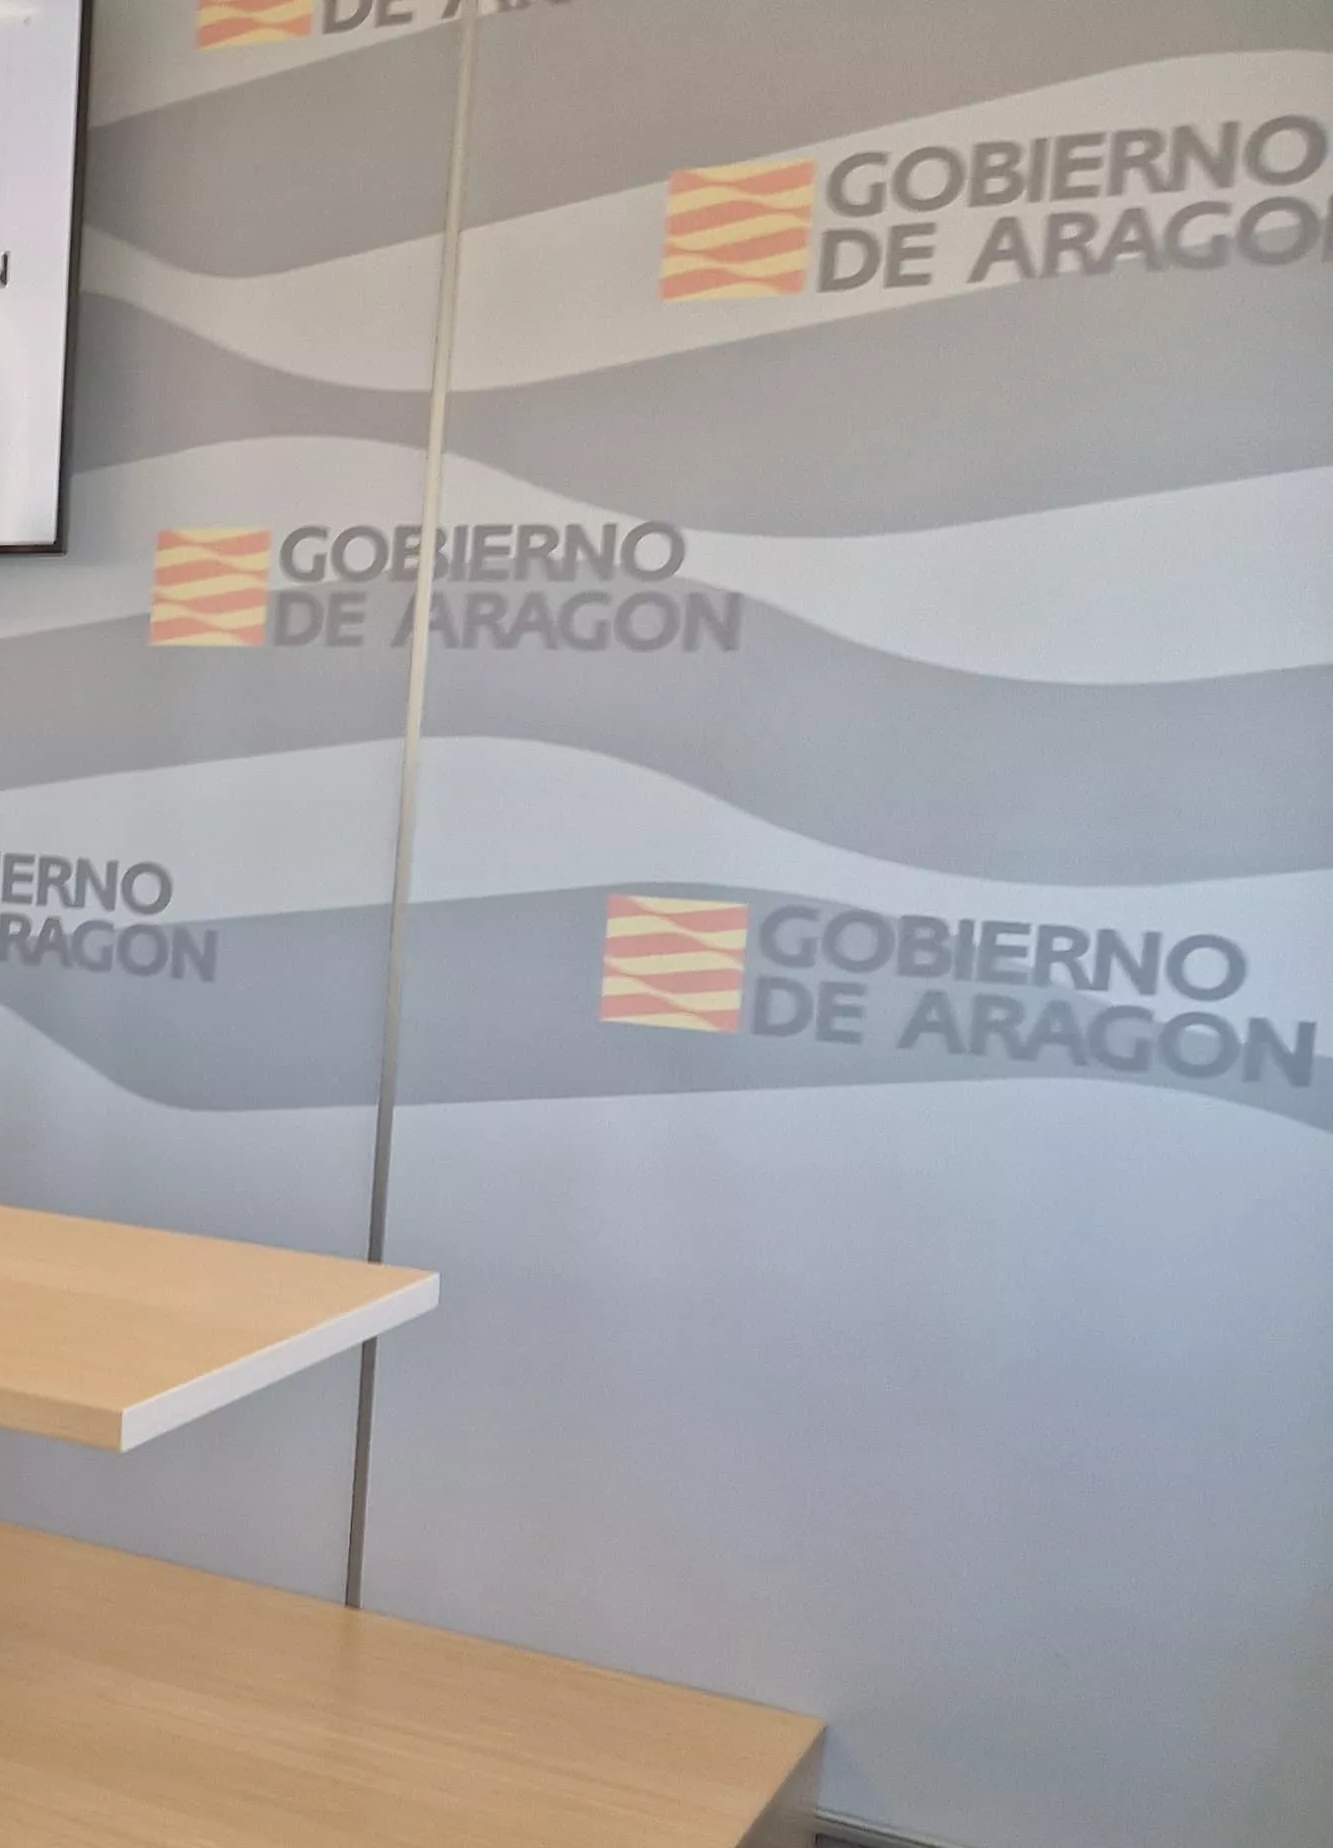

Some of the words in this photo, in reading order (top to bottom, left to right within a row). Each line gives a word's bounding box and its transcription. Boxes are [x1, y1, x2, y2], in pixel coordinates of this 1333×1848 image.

[826, 114, 1329, 217] GOBIERNO
[817, 222, 937, 293] DE
[967, 193, 1333, 284] ARAGO
[279, 520, 687, 584] GOBIERNO
[272, 590, 367, 648] DE
[390, 590, 745, 653] ARAGON
[757, 904, 1248, 1002] GOBIERNO
[751, 977, 867, 1045] DE
[895, 990, 1317, 1088] ARAGON
